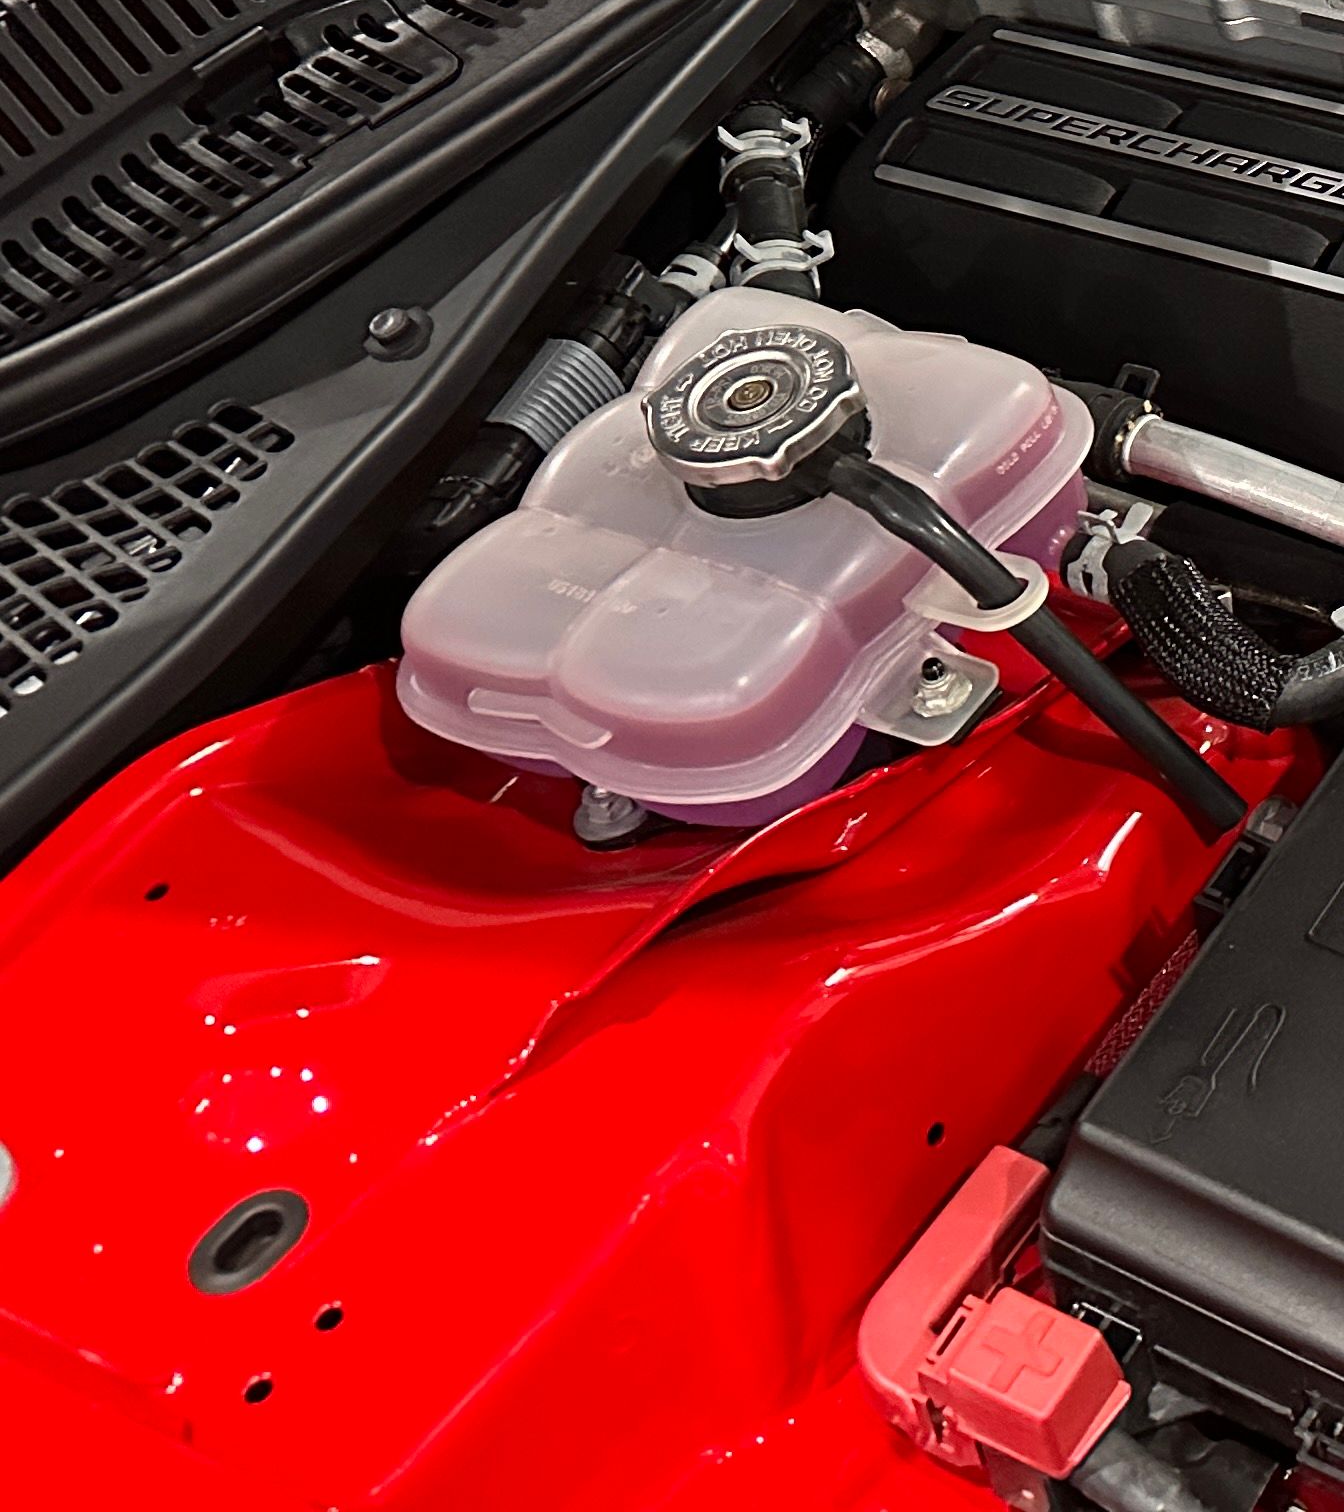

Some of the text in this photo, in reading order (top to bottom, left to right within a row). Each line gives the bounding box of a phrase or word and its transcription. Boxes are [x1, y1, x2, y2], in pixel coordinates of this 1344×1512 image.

[811, 348, 837, 385] NOT
[660, 394, 691, 443] TIGHT
[689, 431, 761, 454] KEEP
